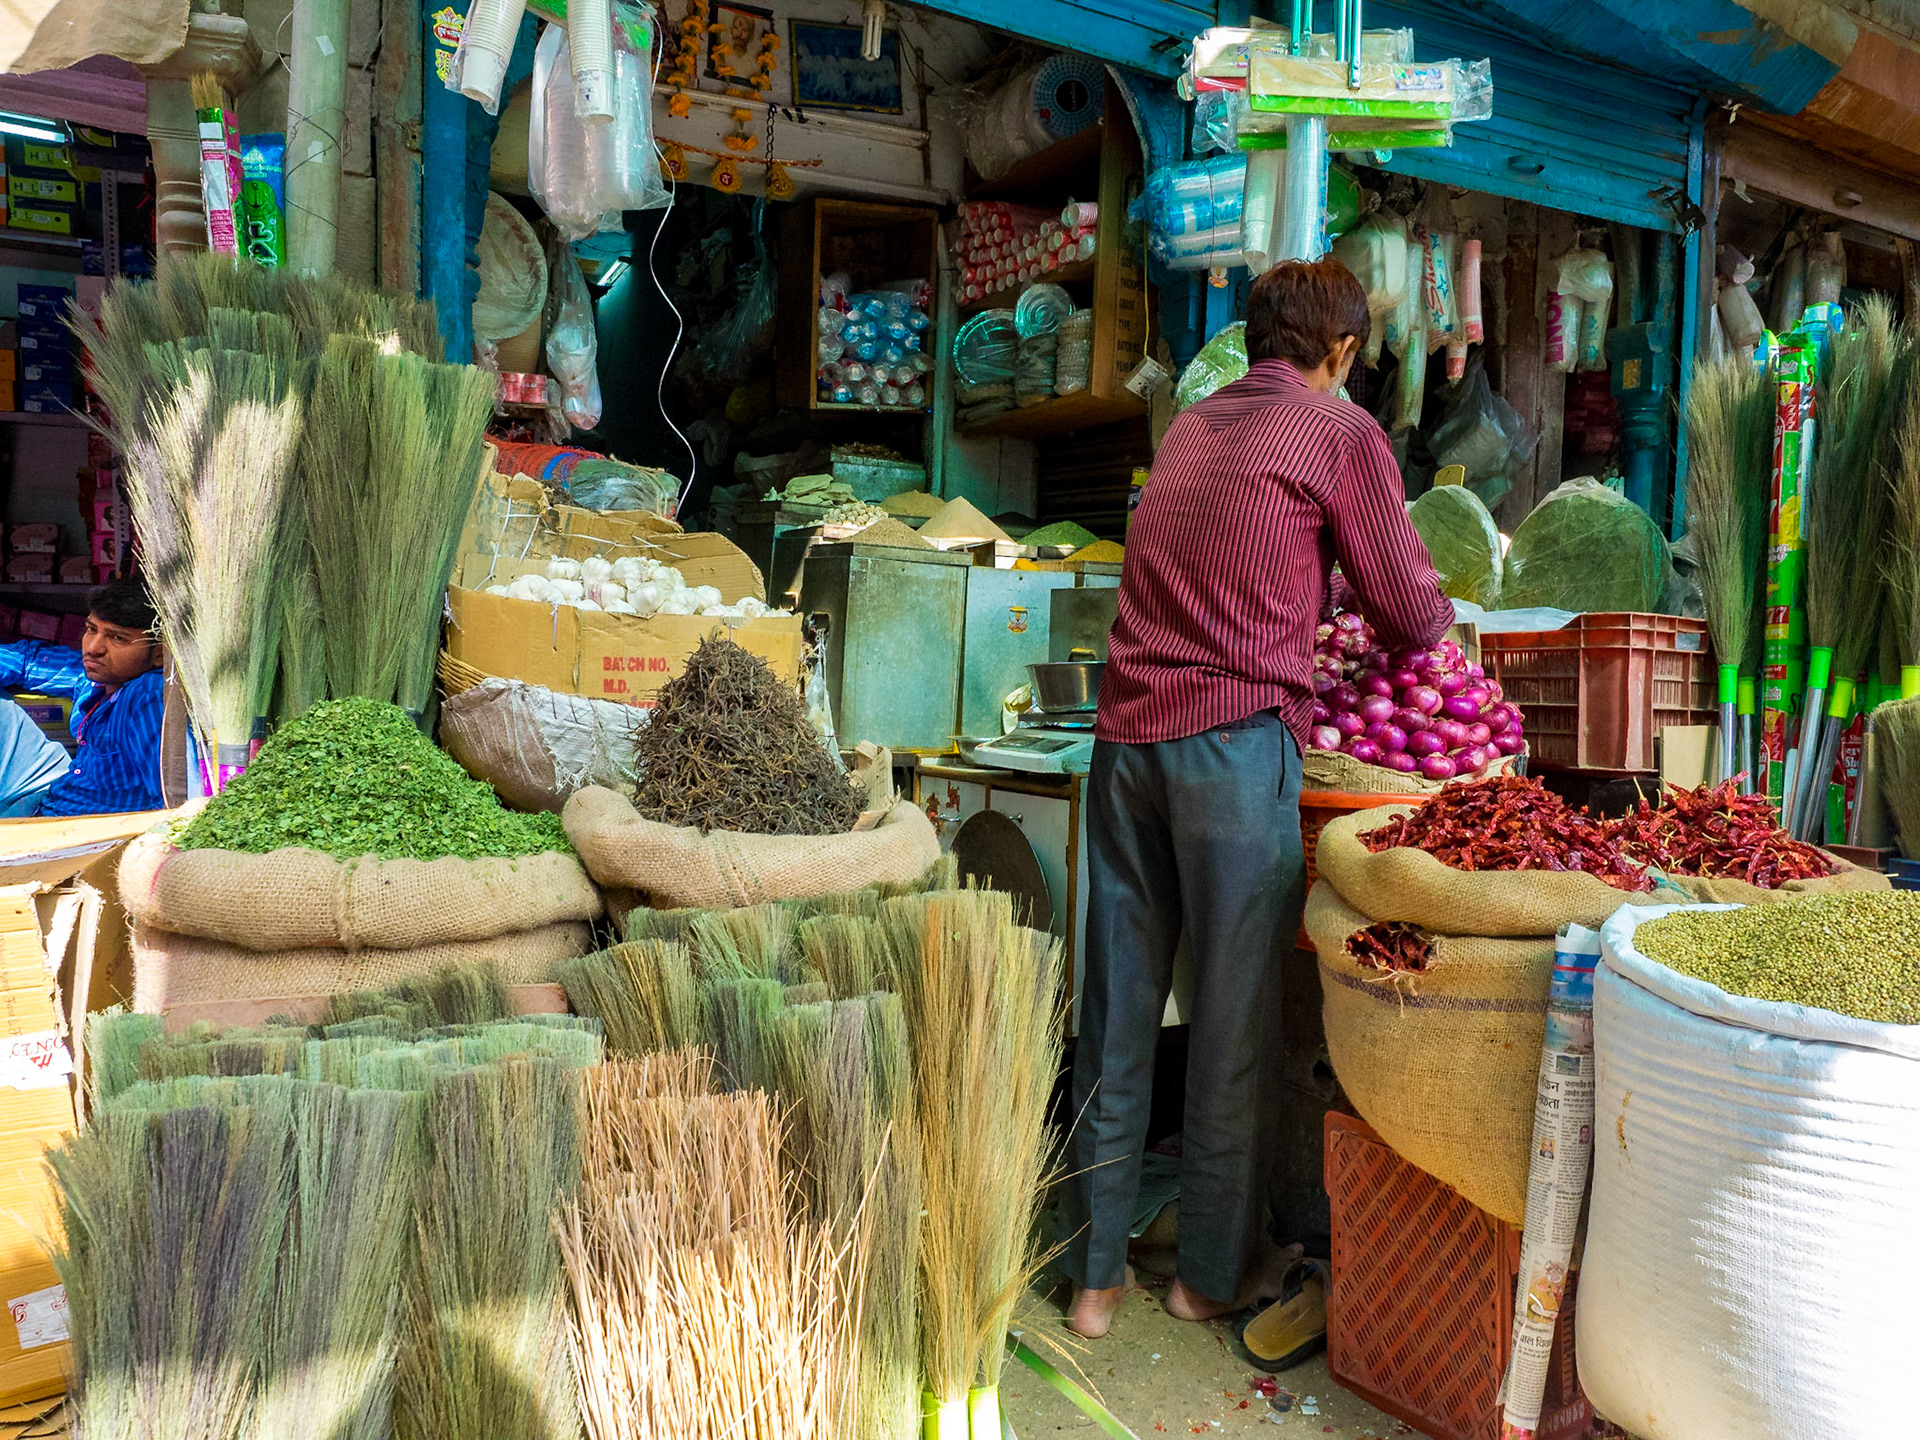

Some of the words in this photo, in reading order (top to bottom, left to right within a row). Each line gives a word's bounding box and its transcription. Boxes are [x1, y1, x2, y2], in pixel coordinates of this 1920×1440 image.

[1118, 319, 1130, 331] TYPE
[602, 656, 645, 672] BATCH
[648, 657, 670, 673] NO.
[603, 678, 631, 694] M.D.
